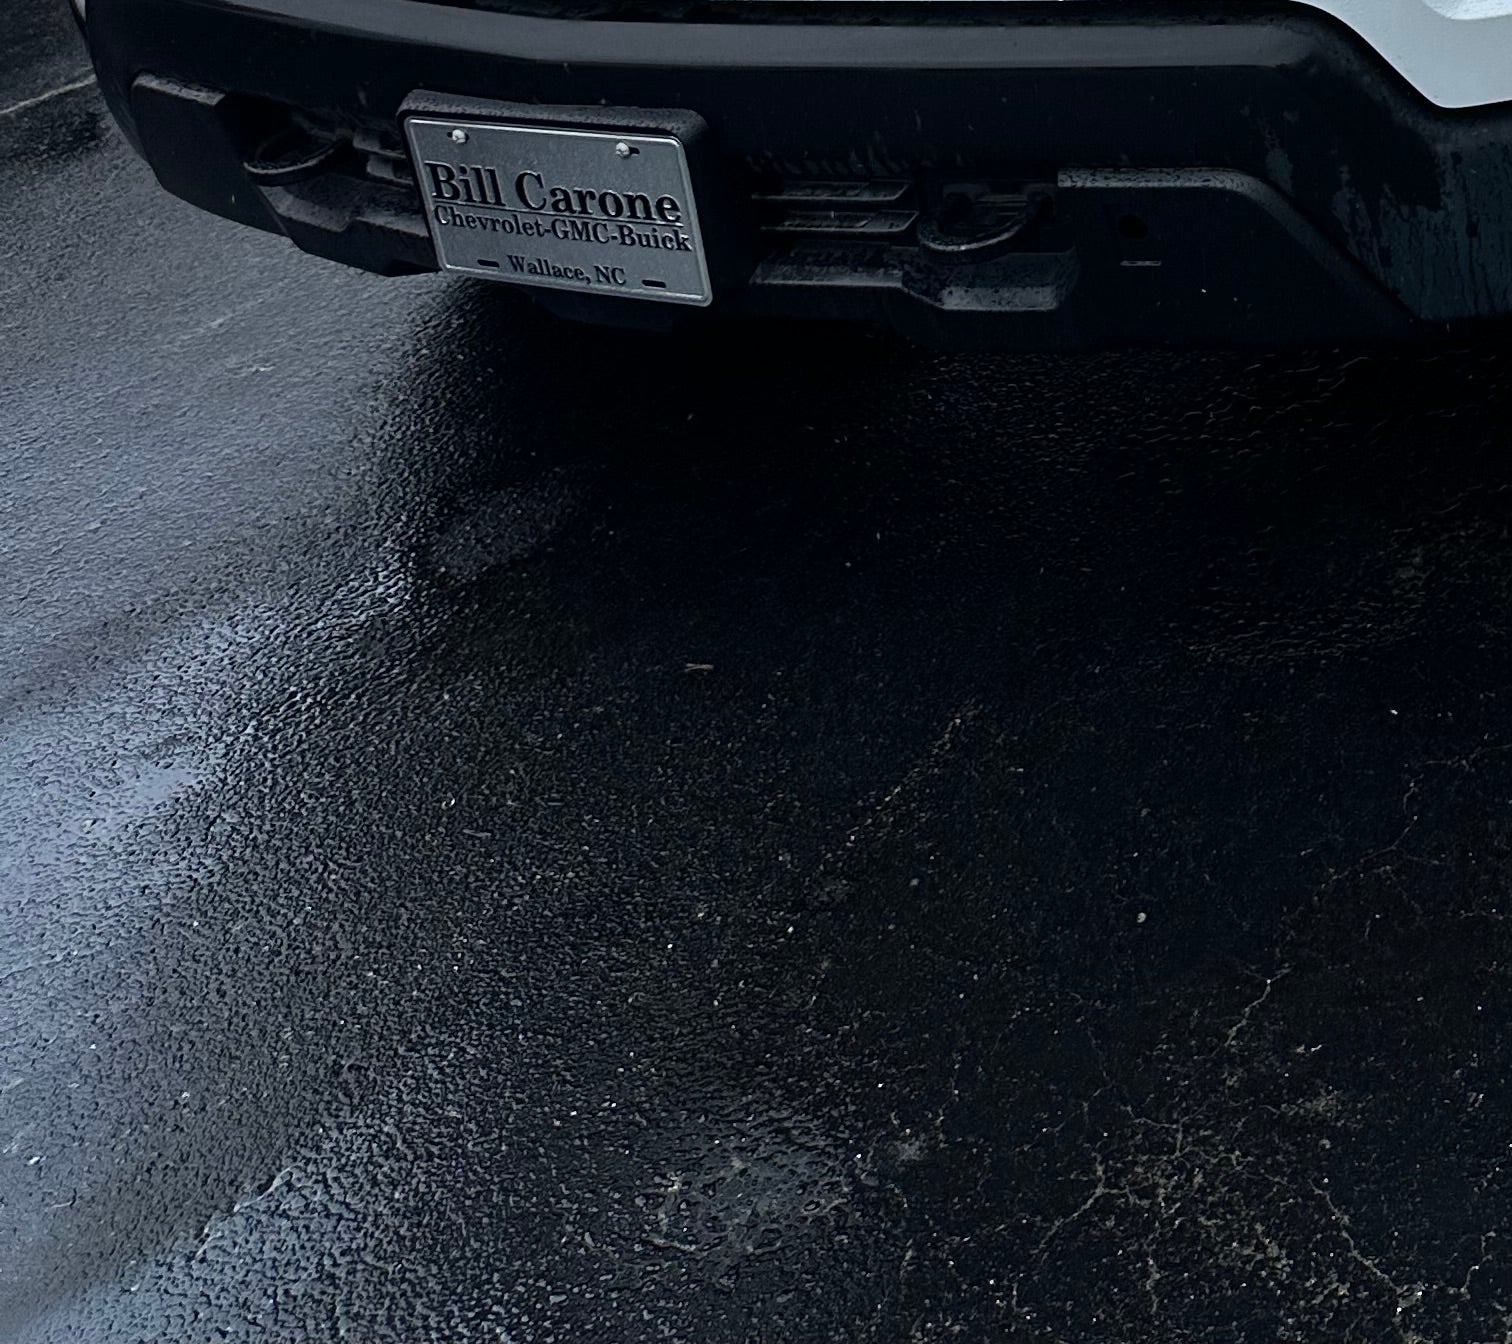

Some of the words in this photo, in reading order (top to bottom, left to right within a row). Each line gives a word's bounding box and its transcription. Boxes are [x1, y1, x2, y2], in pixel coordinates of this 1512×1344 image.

[424, 161, 506, 206] Bill
[515, 170, 682, 223] Carone
[434, 204, 694, 252] Chevrolet-GMC-Buick
[506, 254, 592, 285] Wallace,
[595, 265, 628, 286] NC
